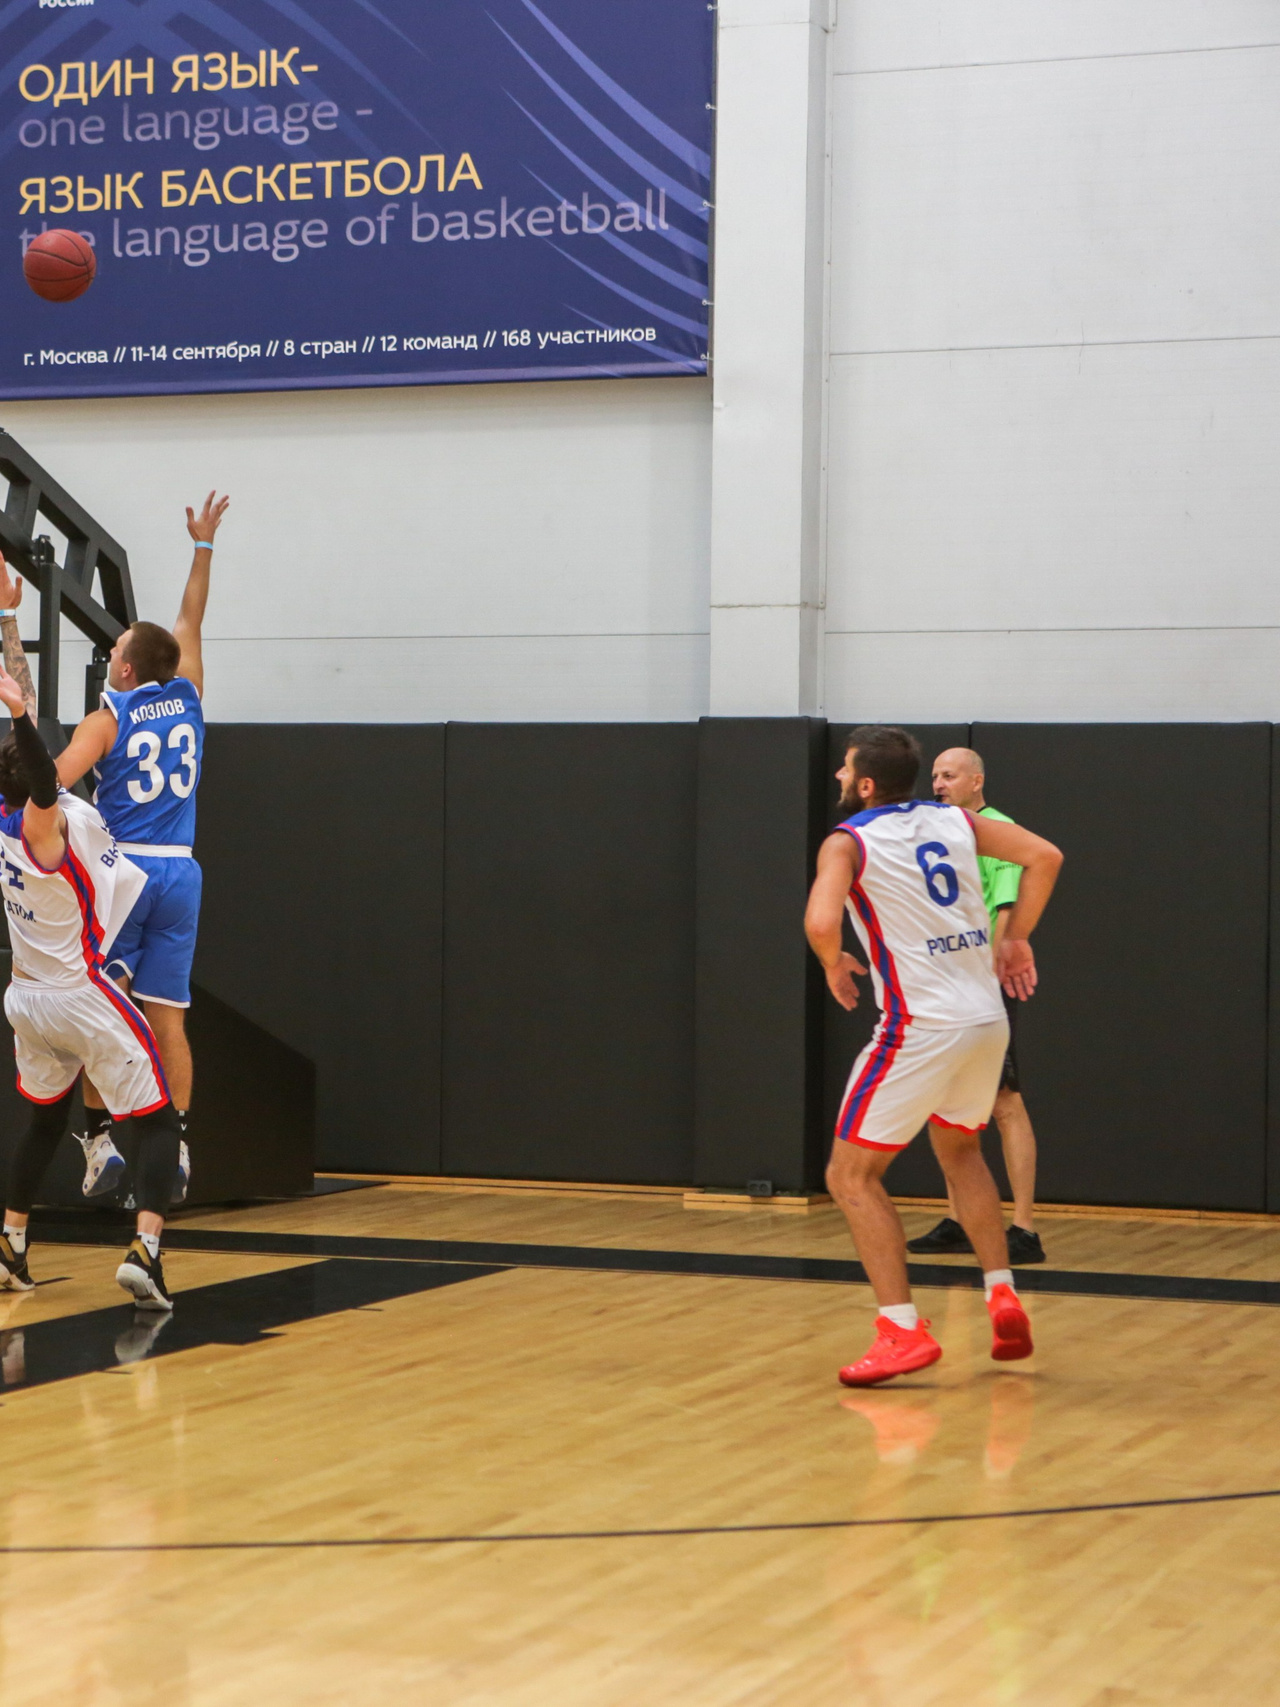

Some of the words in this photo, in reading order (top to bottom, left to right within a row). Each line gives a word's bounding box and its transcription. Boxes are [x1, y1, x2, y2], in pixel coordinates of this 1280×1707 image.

[18, 58, 154, 107] ОДИН
[170, 47, 319, 93] ЯЗЫК-
[19, 115, 105, 147] one
[122, 99, 339, 151] language
[18, 171, 144, 215] ЯЗЫК
[161, 152, 483, 207] БАСКЕТБОЛА
[113, 217, 329, 267] language
[345, 203, 400, 246] of
[411, 187, 669, 243] basketball
[24, 353, 35, 366] г.
[40, 350, 109, 365] Москва
[130, 345, 167, 362] 11-14
[172, 341, 261, 362] сентября
[283, 340, 295, 356] 8
[300, 339, 357, 358] стран
[380, 335, 397, 352] 12
[403, 333, 478, 350] команд
[501, 329, 531, 347] 168
[536, 327, 657, 349] участников
[128, 698, 186, 725] КОЗЛОВ
[126, 723, 197, 804] 33
[915, 841, 959, 907] 6
